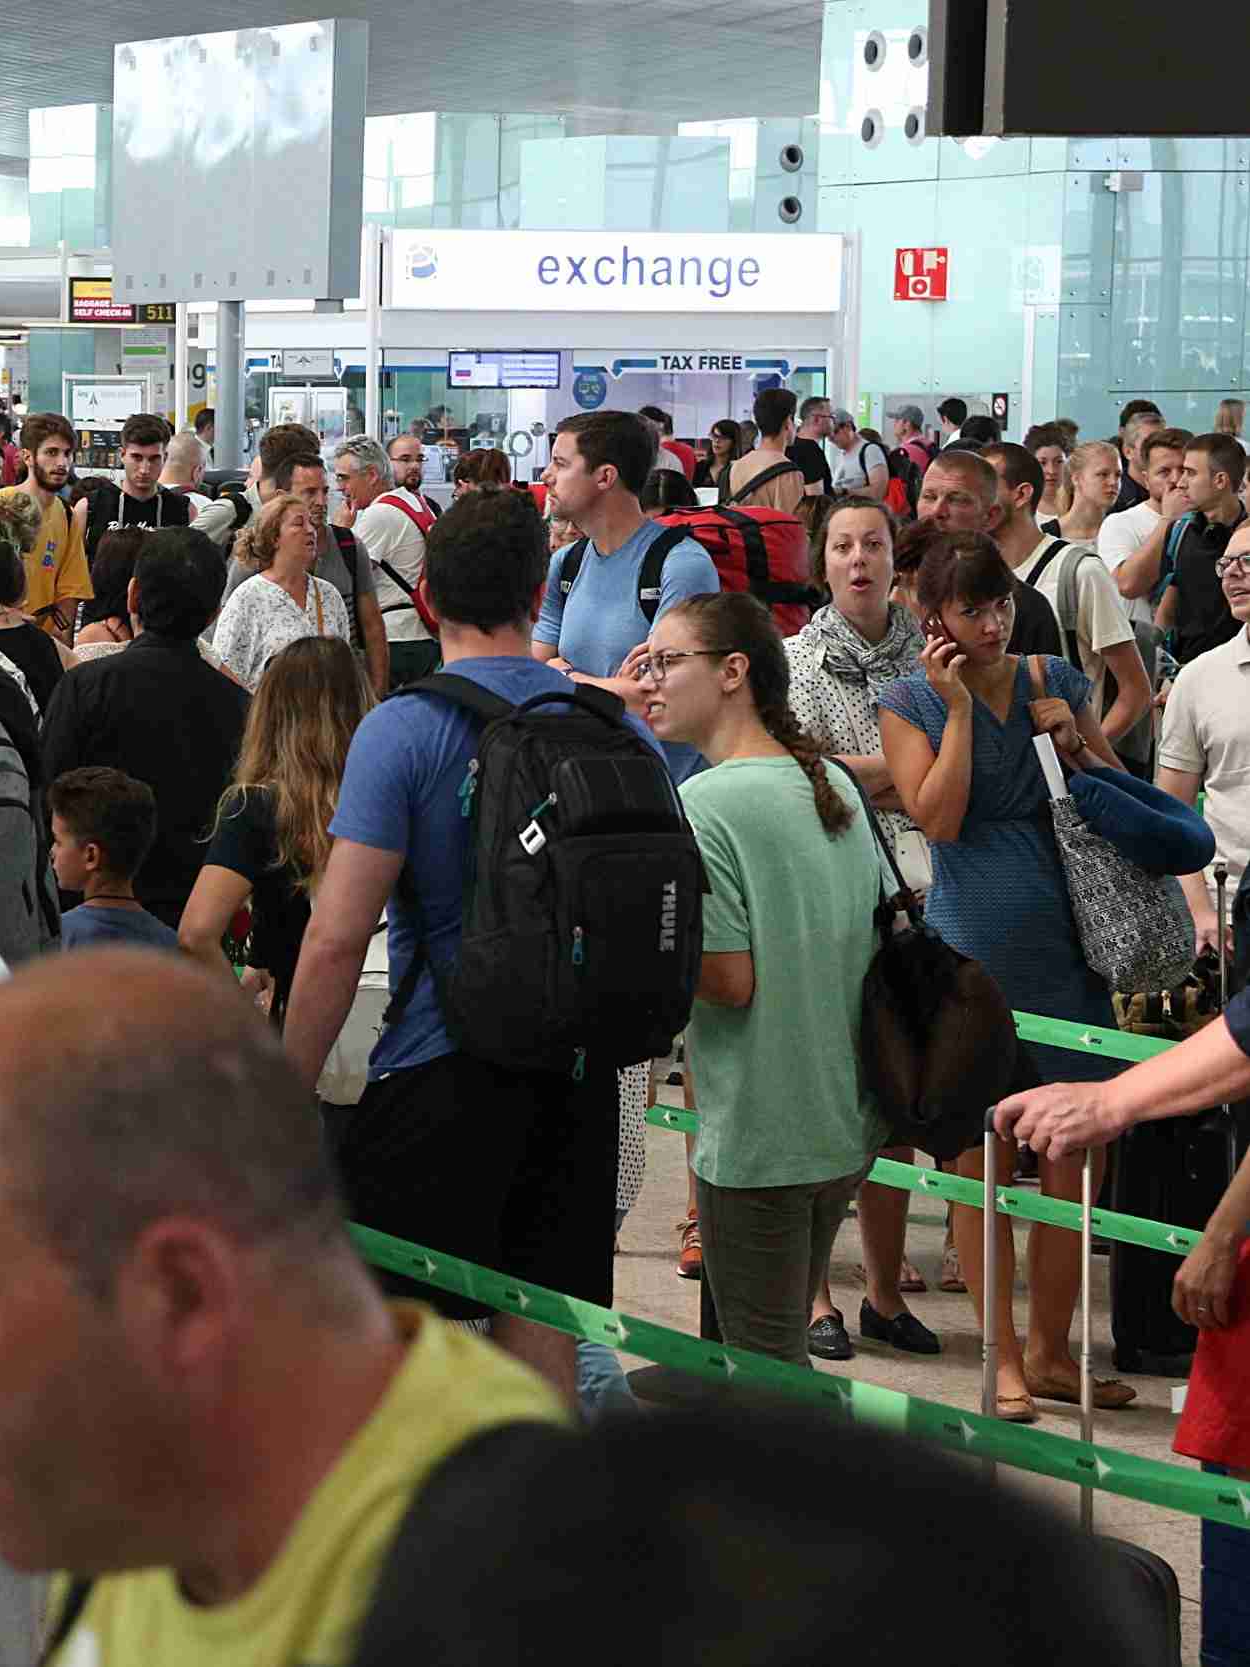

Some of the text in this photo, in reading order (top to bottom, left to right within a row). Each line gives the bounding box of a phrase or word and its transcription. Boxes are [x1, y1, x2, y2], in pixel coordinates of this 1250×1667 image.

[536, 245, 761, 298] exchange
[73, 308, 133, 317] SELF CHECK-IN
[146, 305, 174, 320] 511
[660, 356, 743, 371] TAX FREE
[659, 880, 677, 952] THULE
